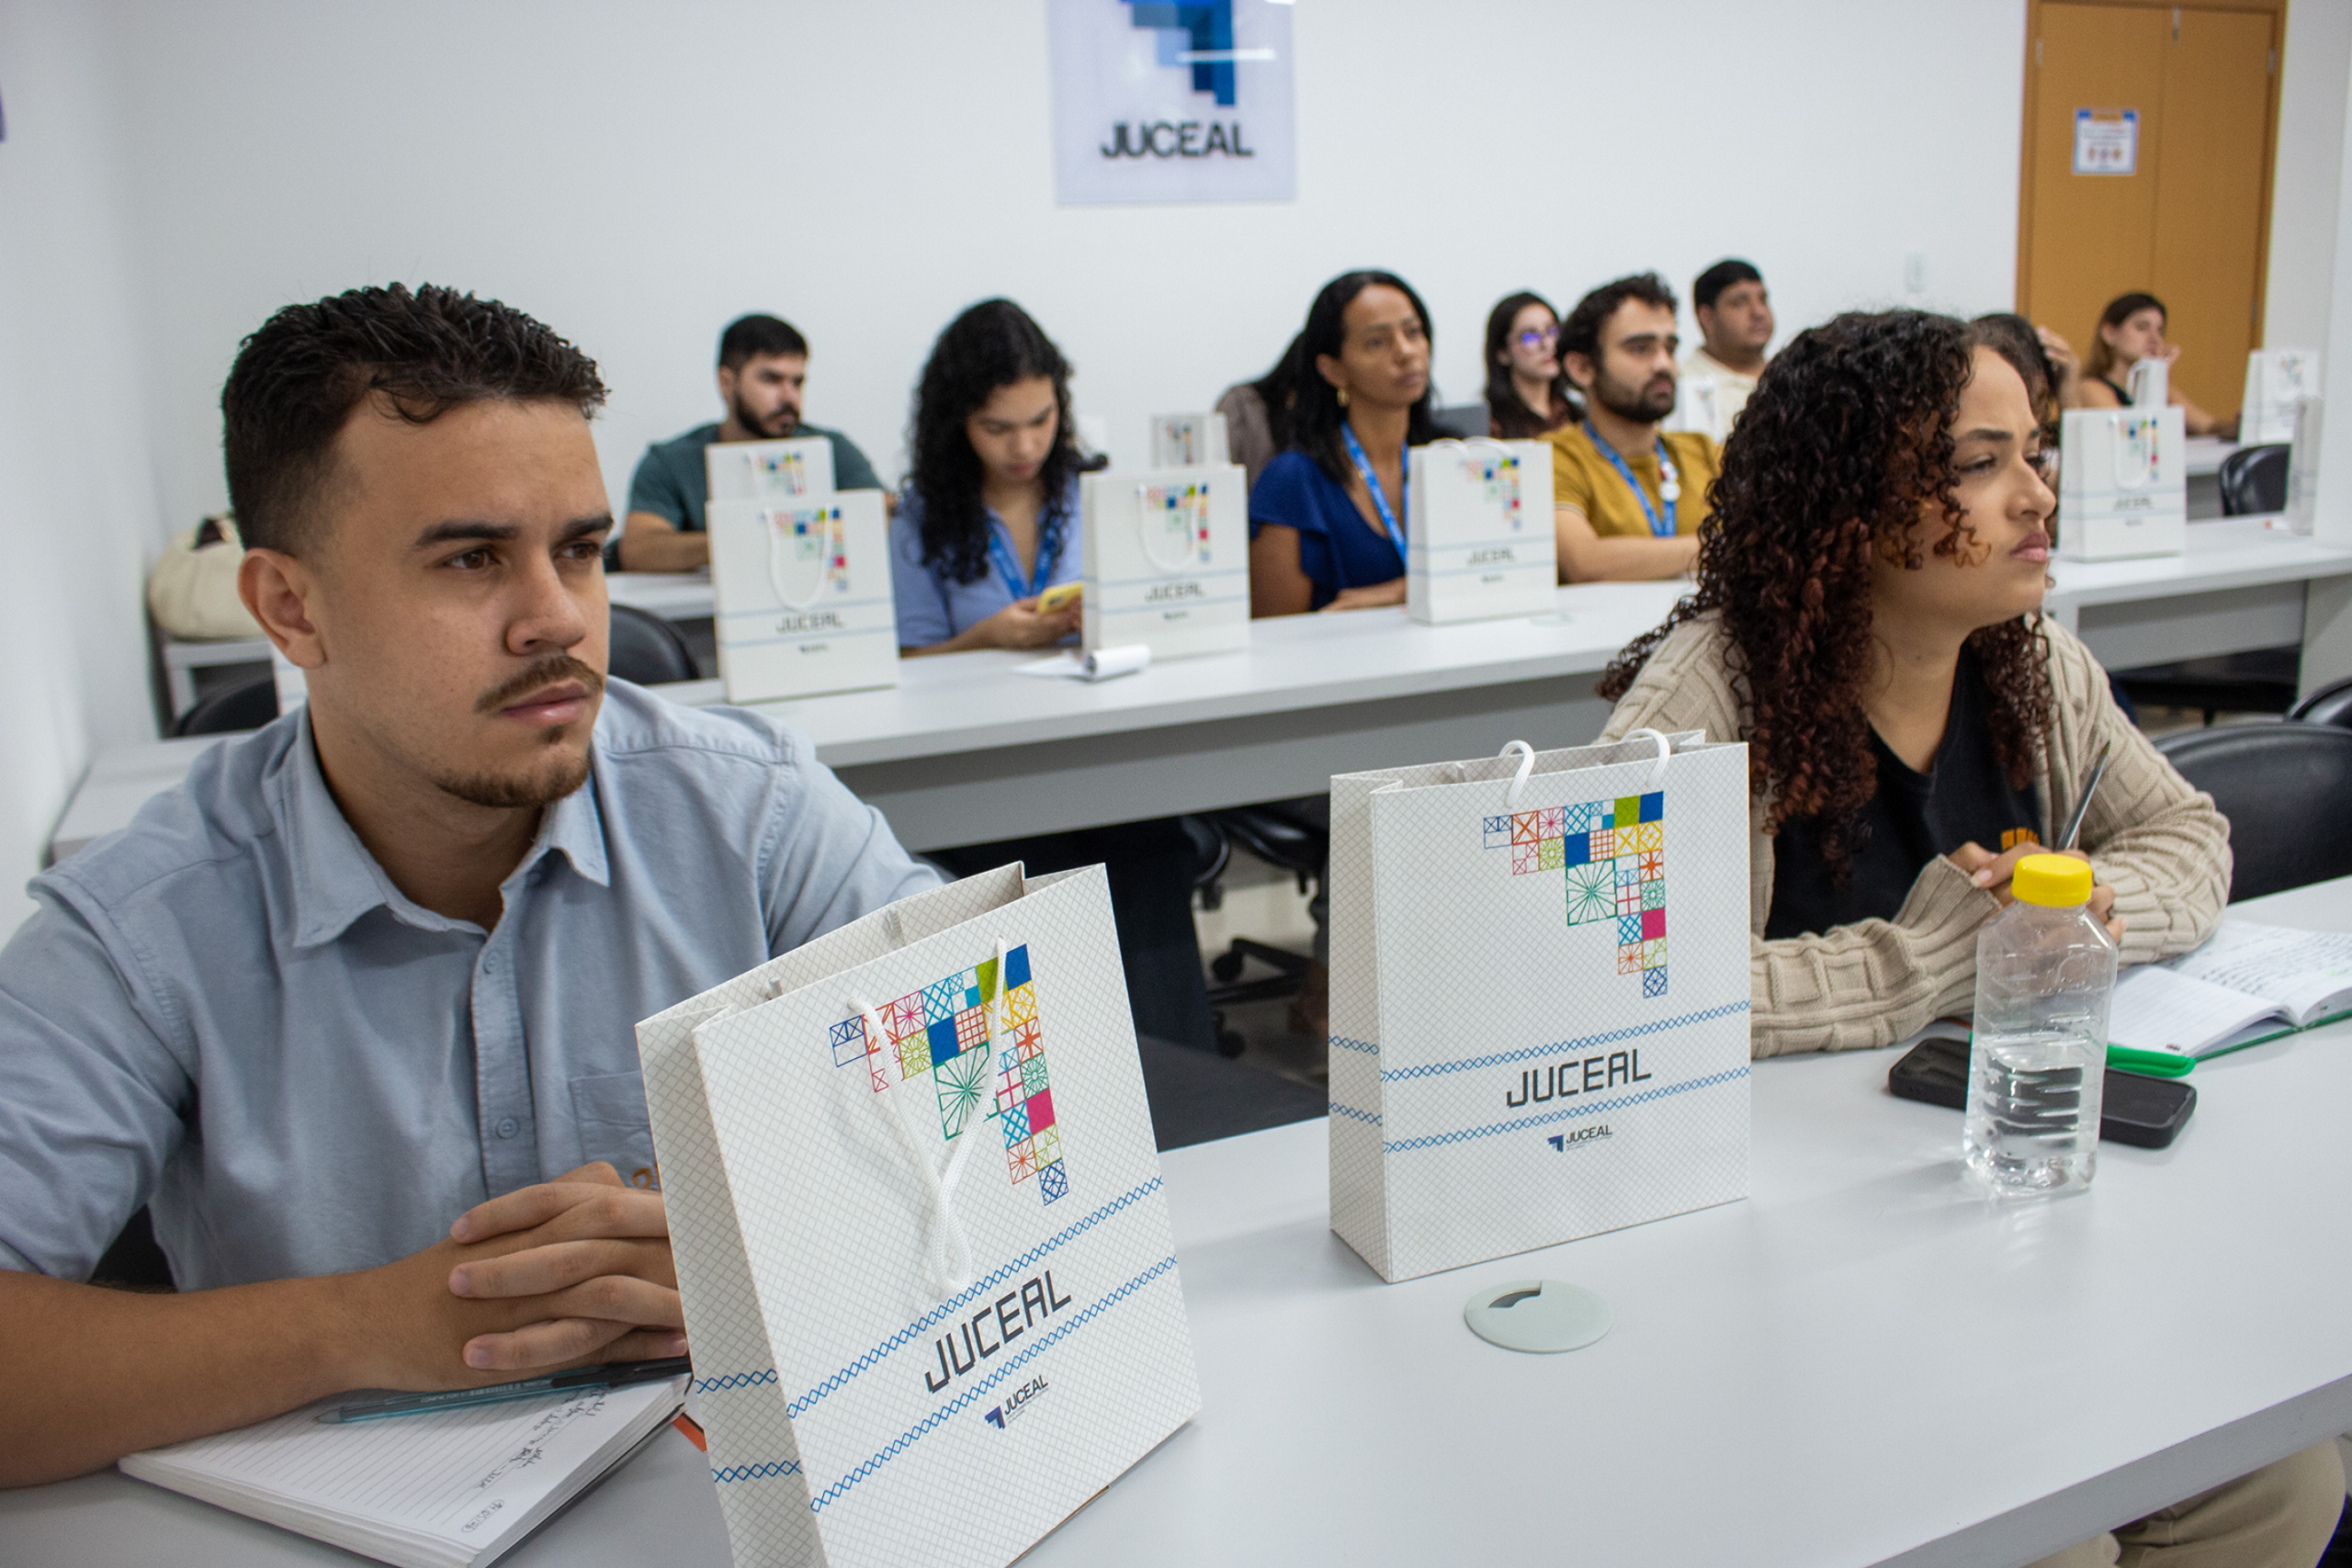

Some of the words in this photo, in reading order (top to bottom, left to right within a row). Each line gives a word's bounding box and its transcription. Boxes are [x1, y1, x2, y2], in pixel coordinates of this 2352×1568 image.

[1101, 121, 1253, 158] JUCEAL
[777, 613, 845, 633] JUCEAL
[1507, 1048, 1652, 1108] JUCEAL
[1566, 1124, 1612, 1144] JUCEAL
[924, 1269, 1072, 1394] JUCEAL
[1004, 1374, 1048, 1416] JUCEAL
